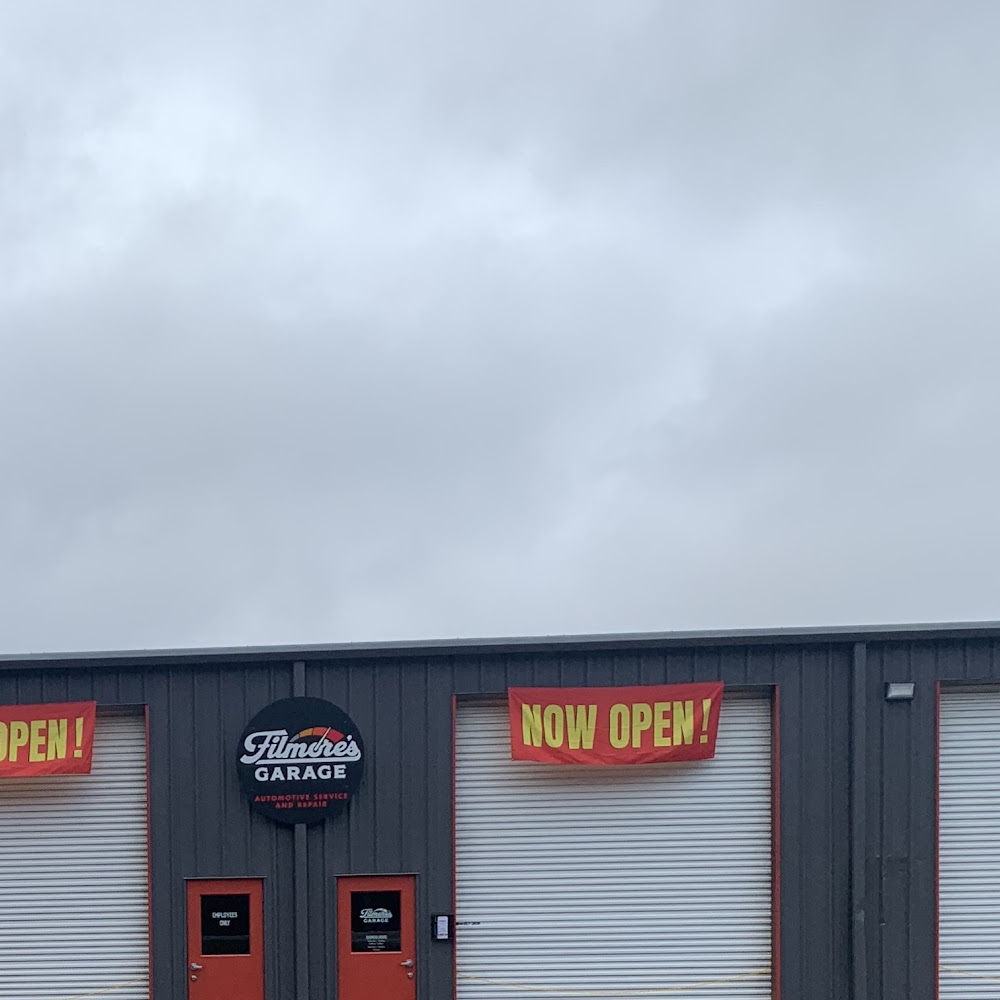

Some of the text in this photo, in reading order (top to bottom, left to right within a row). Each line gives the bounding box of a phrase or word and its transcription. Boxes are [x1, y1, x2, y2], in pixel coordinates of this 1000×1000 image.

[521, 703, 598, 750] NOW
[239, 728, 362, 766] Filmore's
[254, 764, 347, 782] GARAGE
[254, 792, 348, 803] AUTOMOTIVE SERVICE
[274, 800, 328, 809] AND REPAIR
